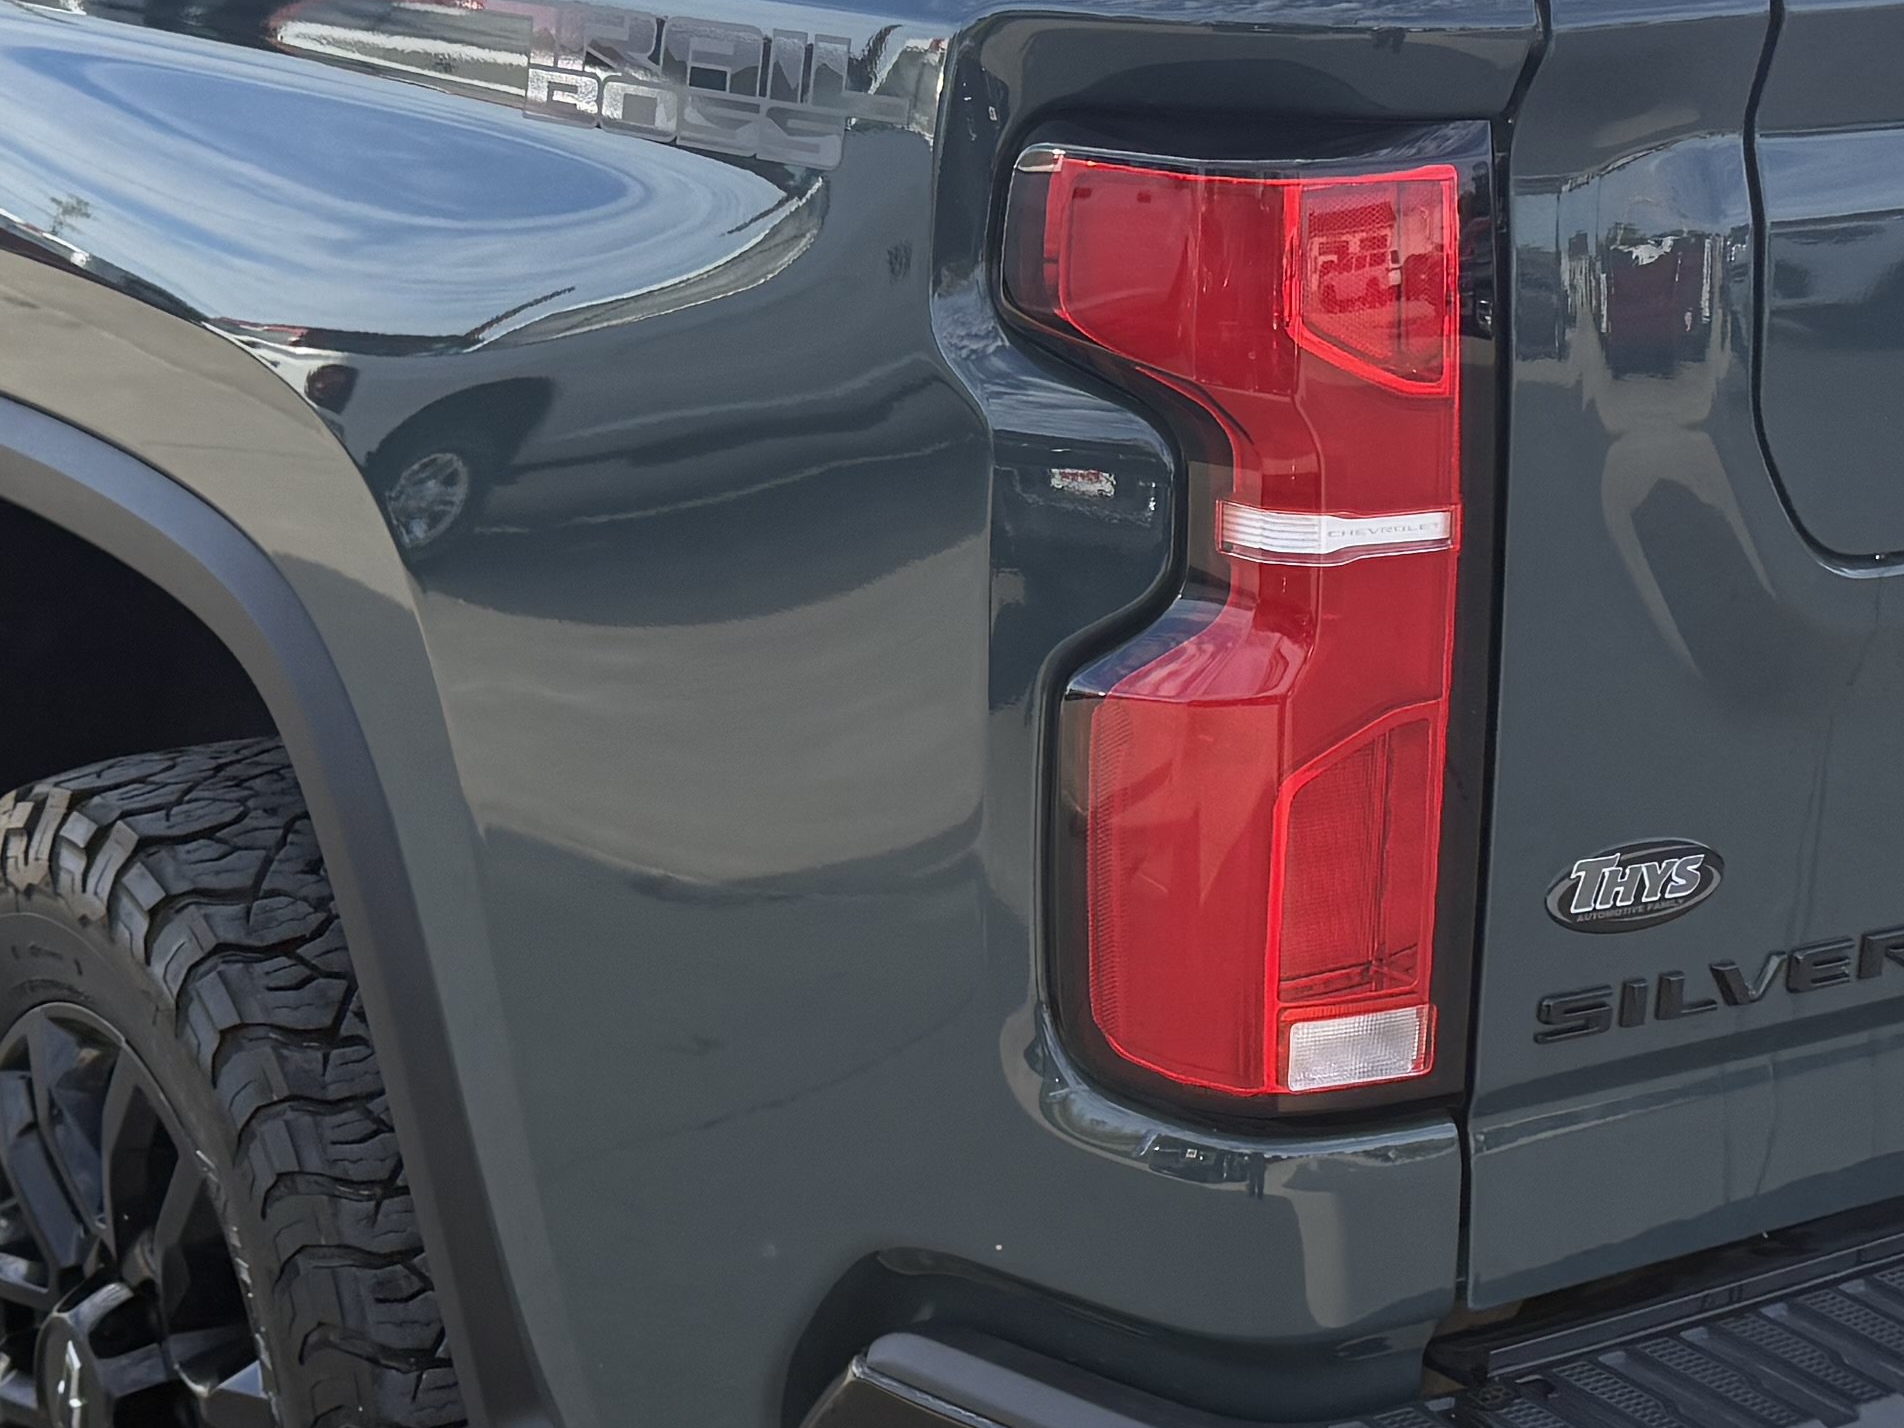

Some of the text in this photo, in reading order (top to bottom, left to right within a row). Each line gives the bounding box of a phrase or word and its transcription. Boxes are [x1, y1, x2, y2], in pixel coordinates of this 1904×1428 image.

[522, 65, 847, 171] BOSS
[1326, 521, 1439, 539] CHEVROLET
[1570, 852, 1705, 913] THYS
[1577, 898, 1686, 923] AUTOMOTIVE FAMILY
